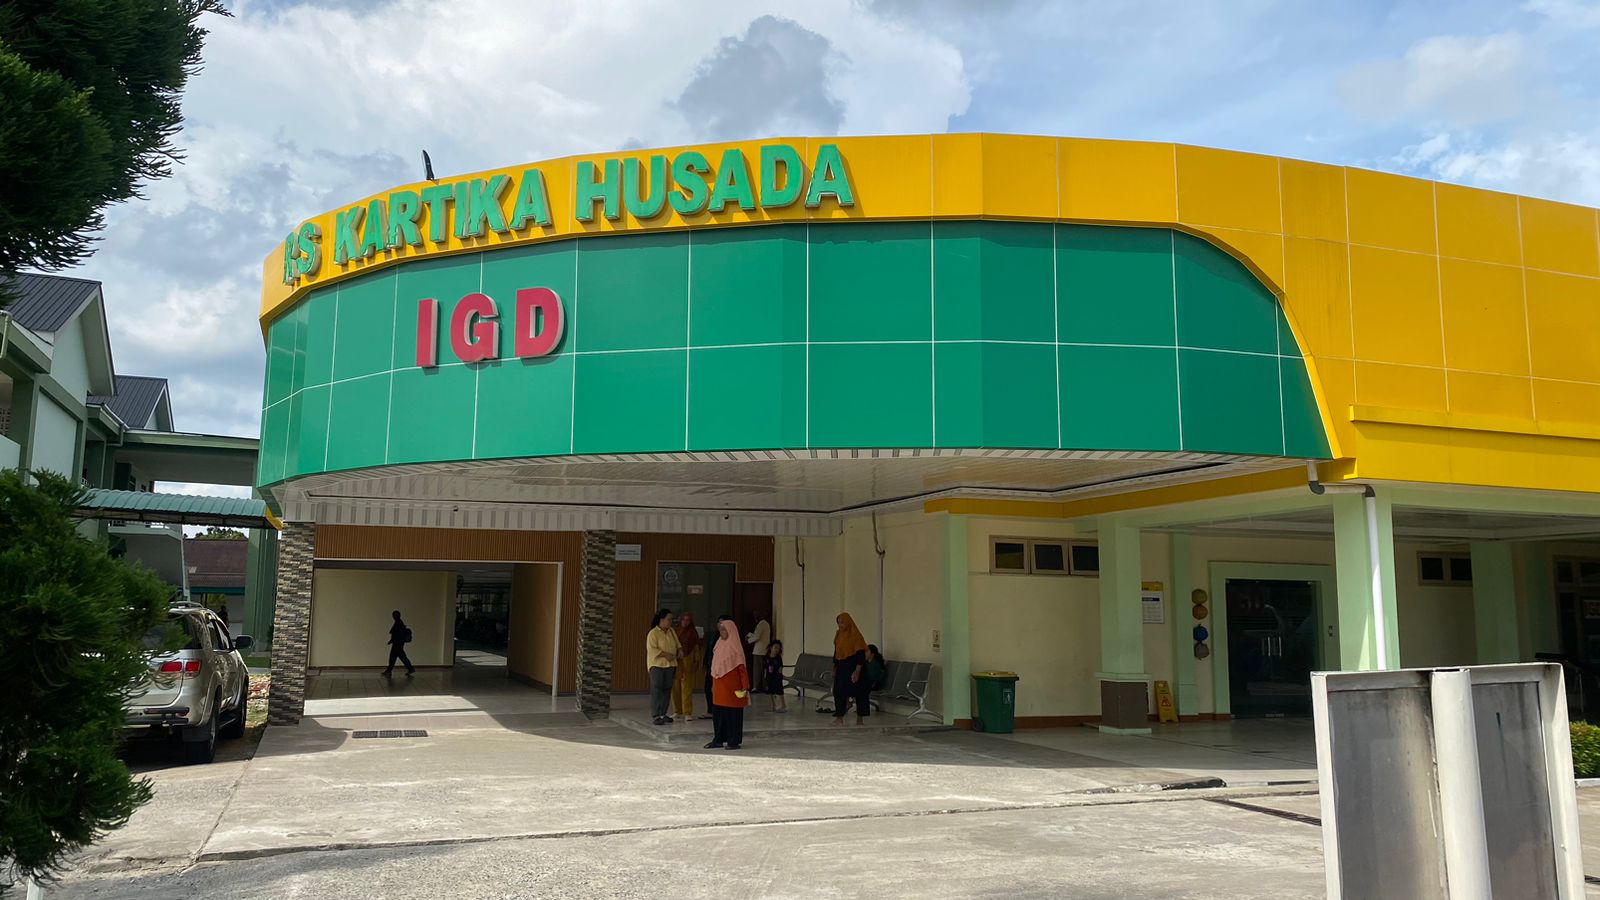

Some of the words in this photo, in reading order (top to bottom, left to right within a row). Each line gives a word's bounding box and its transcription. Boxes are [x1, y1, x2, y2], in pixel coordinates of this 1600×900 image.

[283, 222, 321, 284] RS
[334, 169, 552, 265] KARTIKA
[576, 144, 853, 221] HUSADA
[415, 287, 565, 367] IGD
